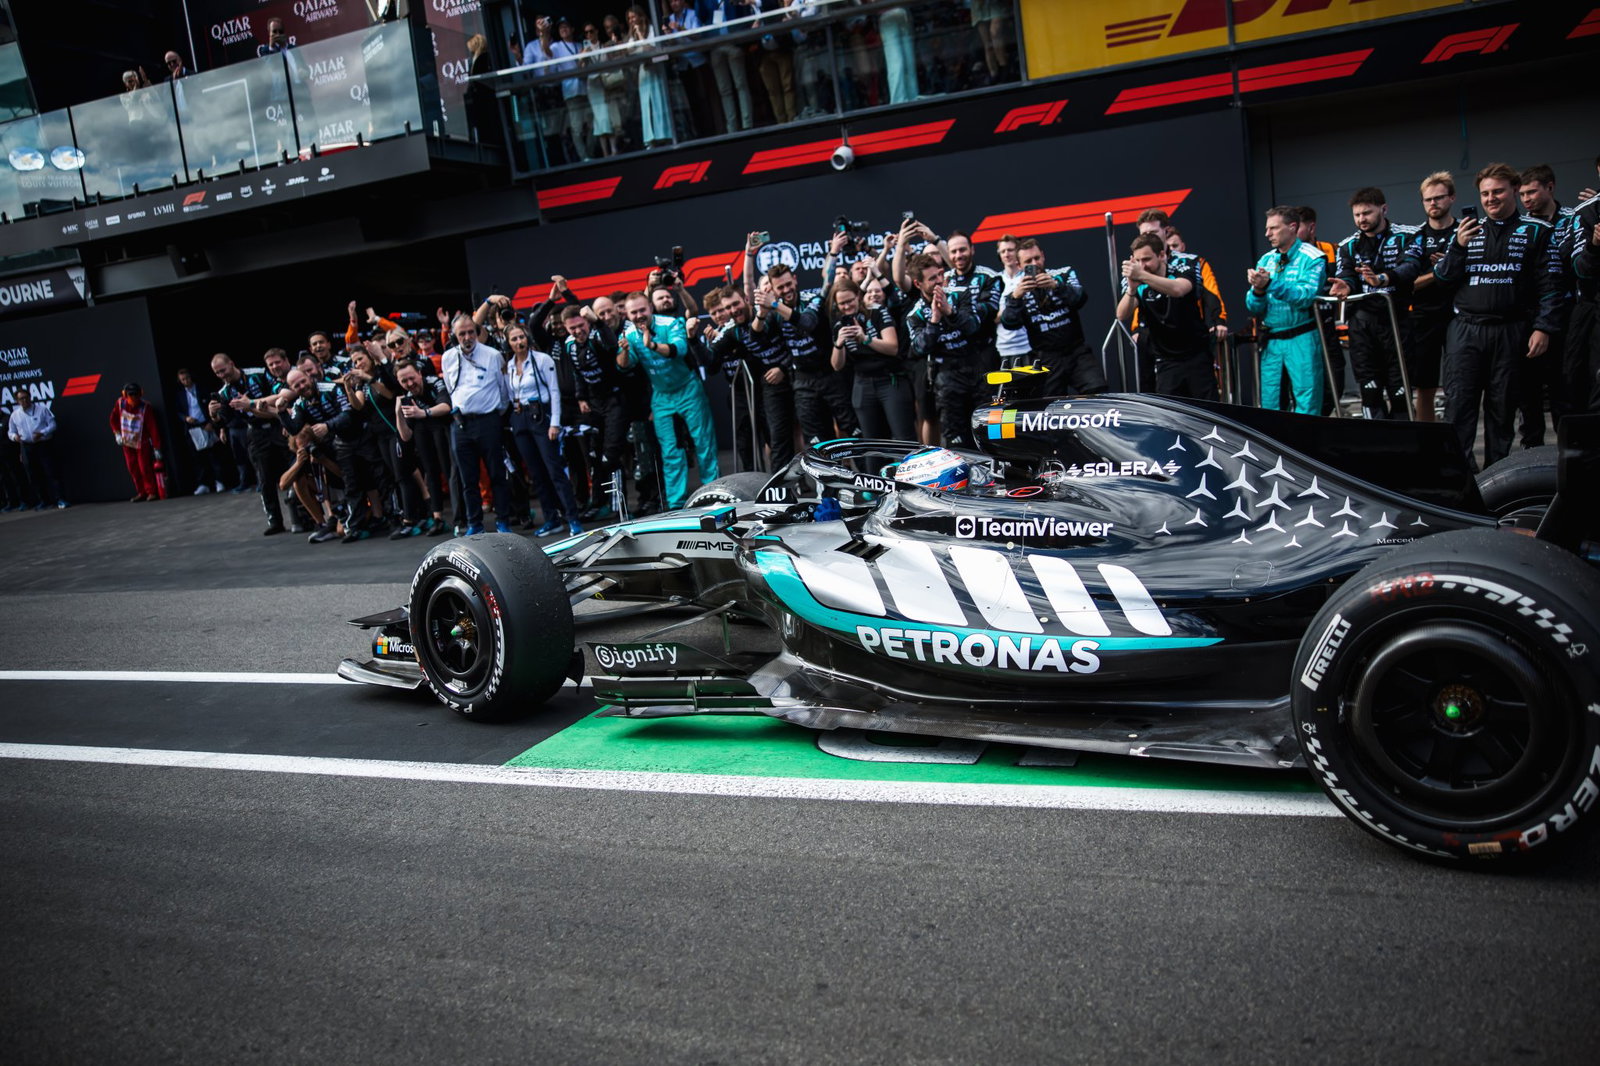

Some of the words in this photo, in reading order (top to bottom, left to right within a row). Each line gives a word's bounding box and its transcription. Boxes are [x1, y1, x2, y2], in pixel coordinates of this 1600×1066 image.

[211, 16, 251, 40] QATAR
[153, 203, 175, 216] LVMH
[799, 242, 824, 257] FIA
[1465, 262, 1523, 273] PETRONAS
[1479, 276, 1514, 285] Microsoft
[0, 346, 29, 363] QATAR
[13, 368, 43, 380] AIRWAYS
[1021, 408, 1123, 433] Microsoft
[1083, 460, 1165, 478] SOLERA
[854, 475, 885, 491] AMD
[978, 517, 1114, 537] TeamViewer
[694, 540, 734, 551] AMG
[447, 550, 481, 581] PIRELLI
[855, 625, 1101, 675] PETRONAS
[1300, 613, 1352, 691] PIRELLI
